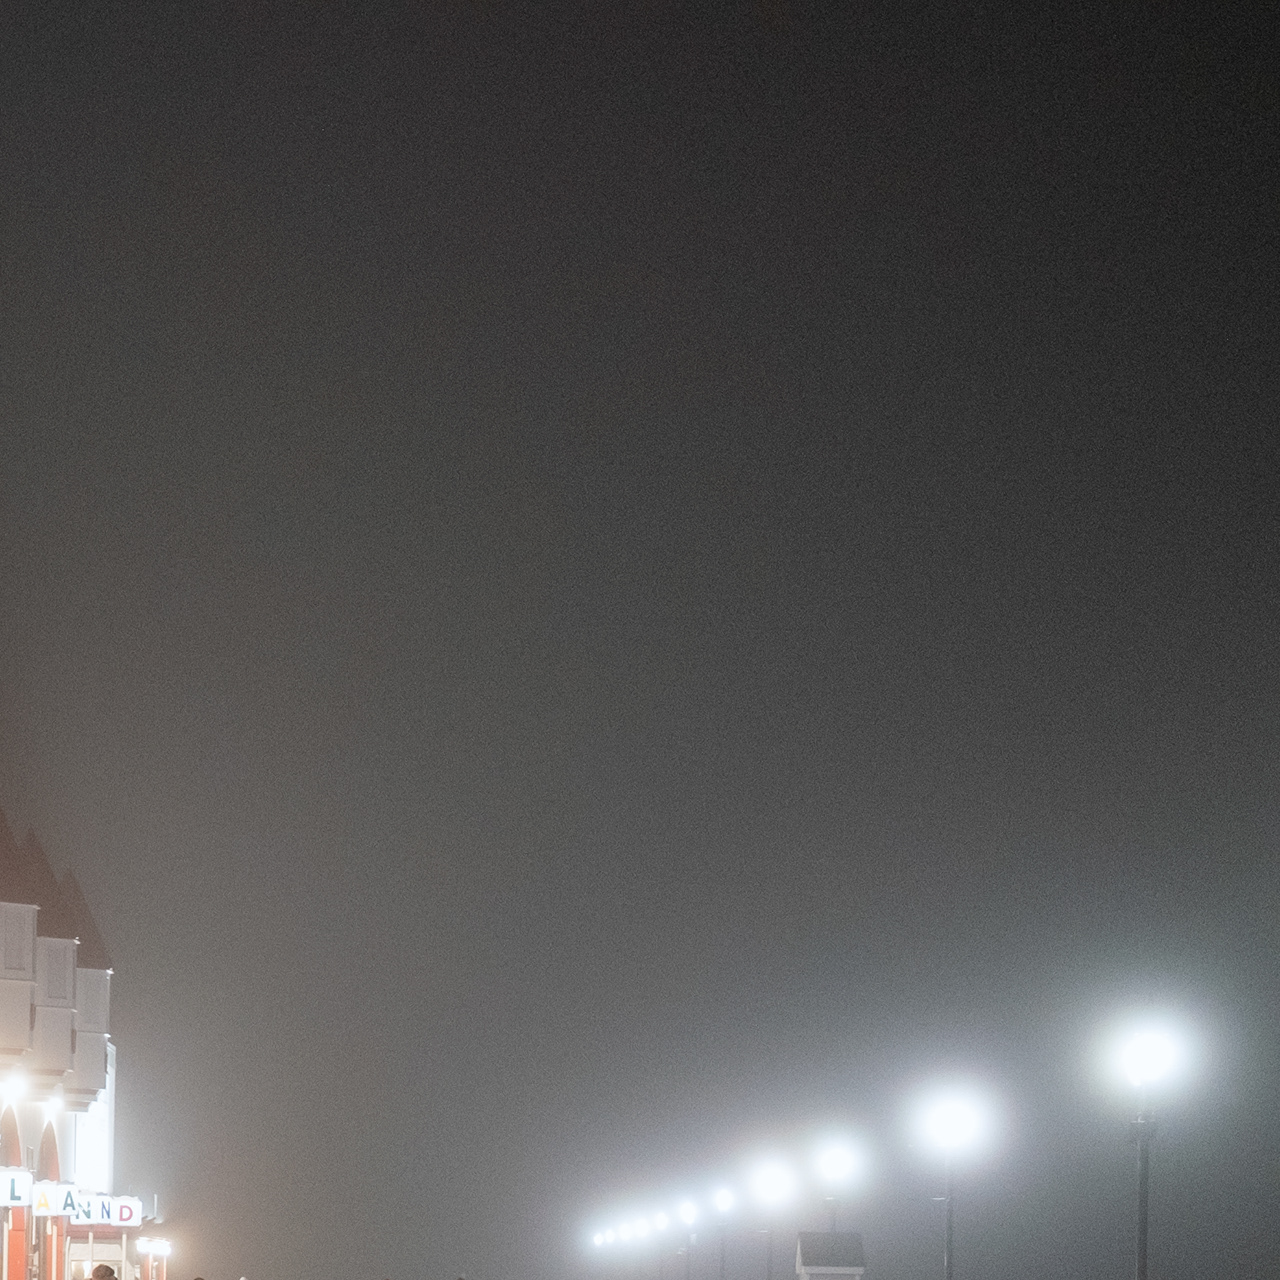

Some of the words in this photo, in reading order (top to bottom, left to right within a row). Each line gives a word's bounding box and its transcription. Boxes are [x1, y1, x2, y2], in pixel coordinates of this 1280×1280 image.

[10, 1178, 21, 1201] L
[36, 1191, 51, 1211] A
[63, 1190, 76, 1211] A
[101, 1201, 111, 1219] N
[119, 1205, 133, 1222] D
